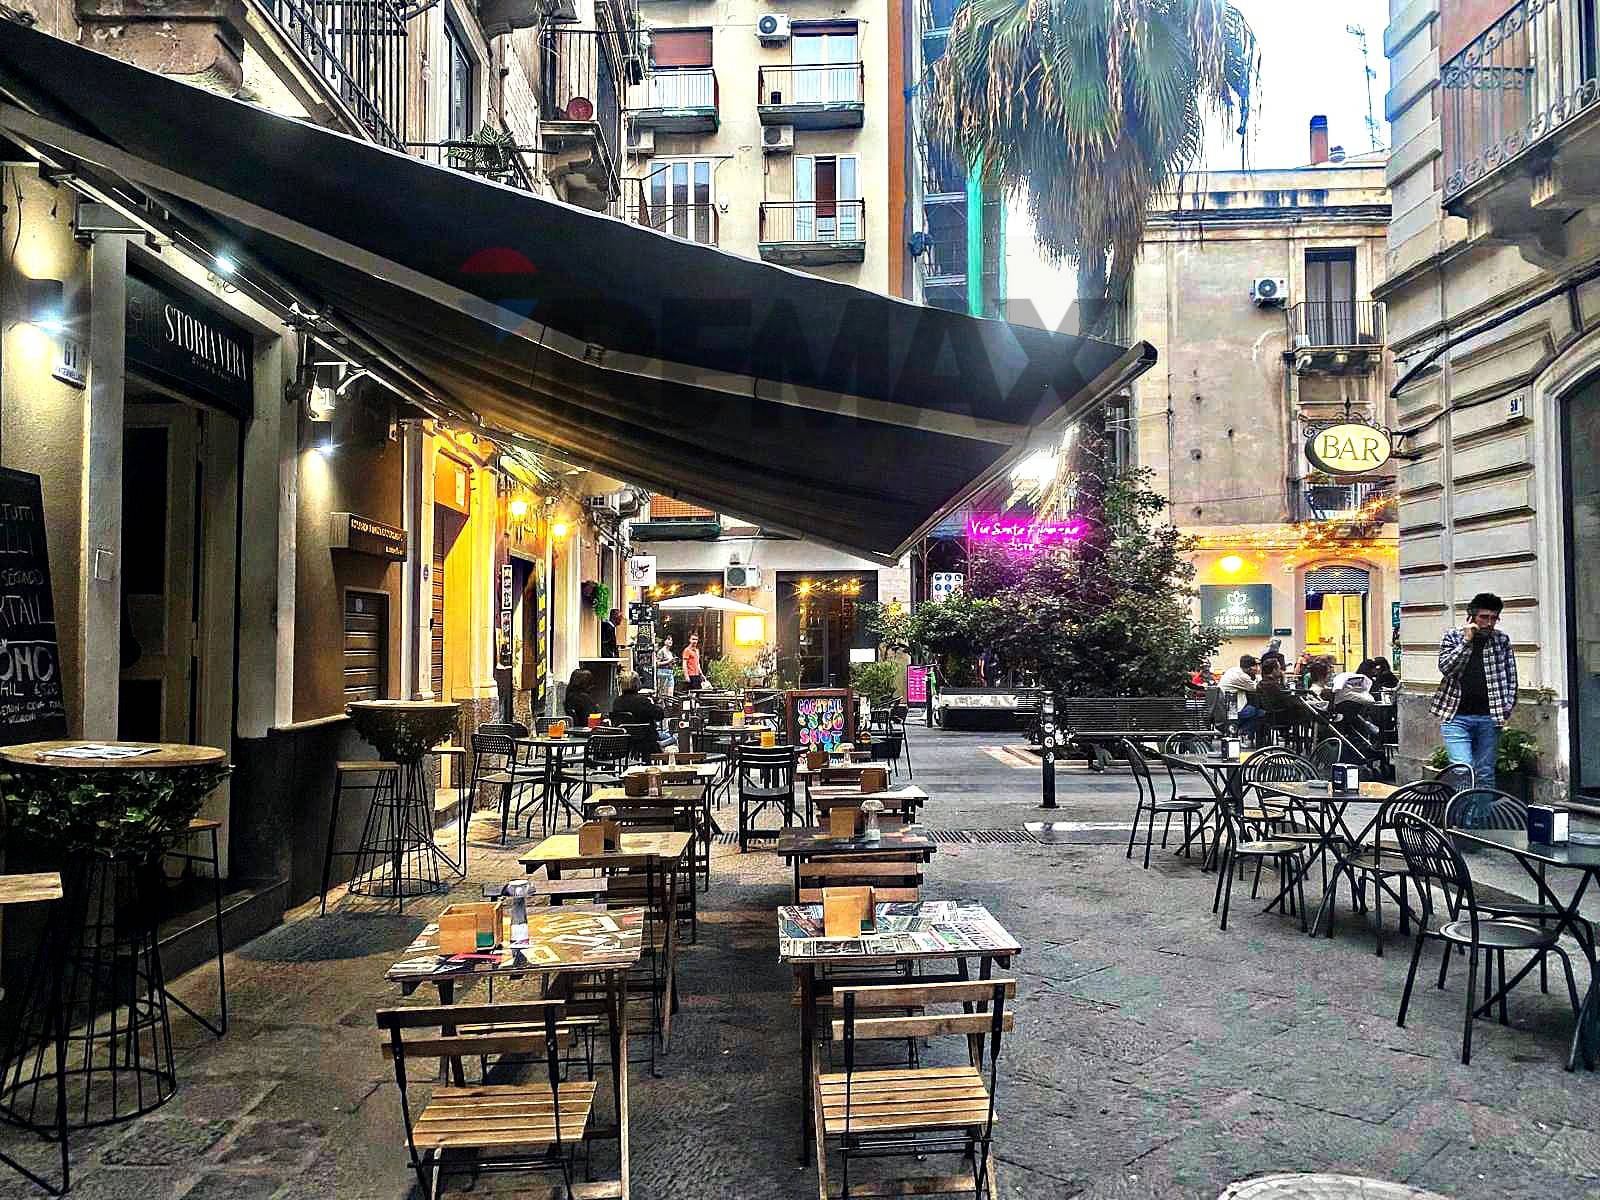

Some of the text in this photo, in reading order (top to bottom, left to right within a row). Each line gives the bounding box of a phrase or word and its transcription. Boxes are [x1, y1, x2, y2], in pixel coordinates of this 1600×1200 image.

[164, 303, 217, 364] STORIA
[1321, 434, 1380, 462] BAR
[971, 520, 991, 535] Via
